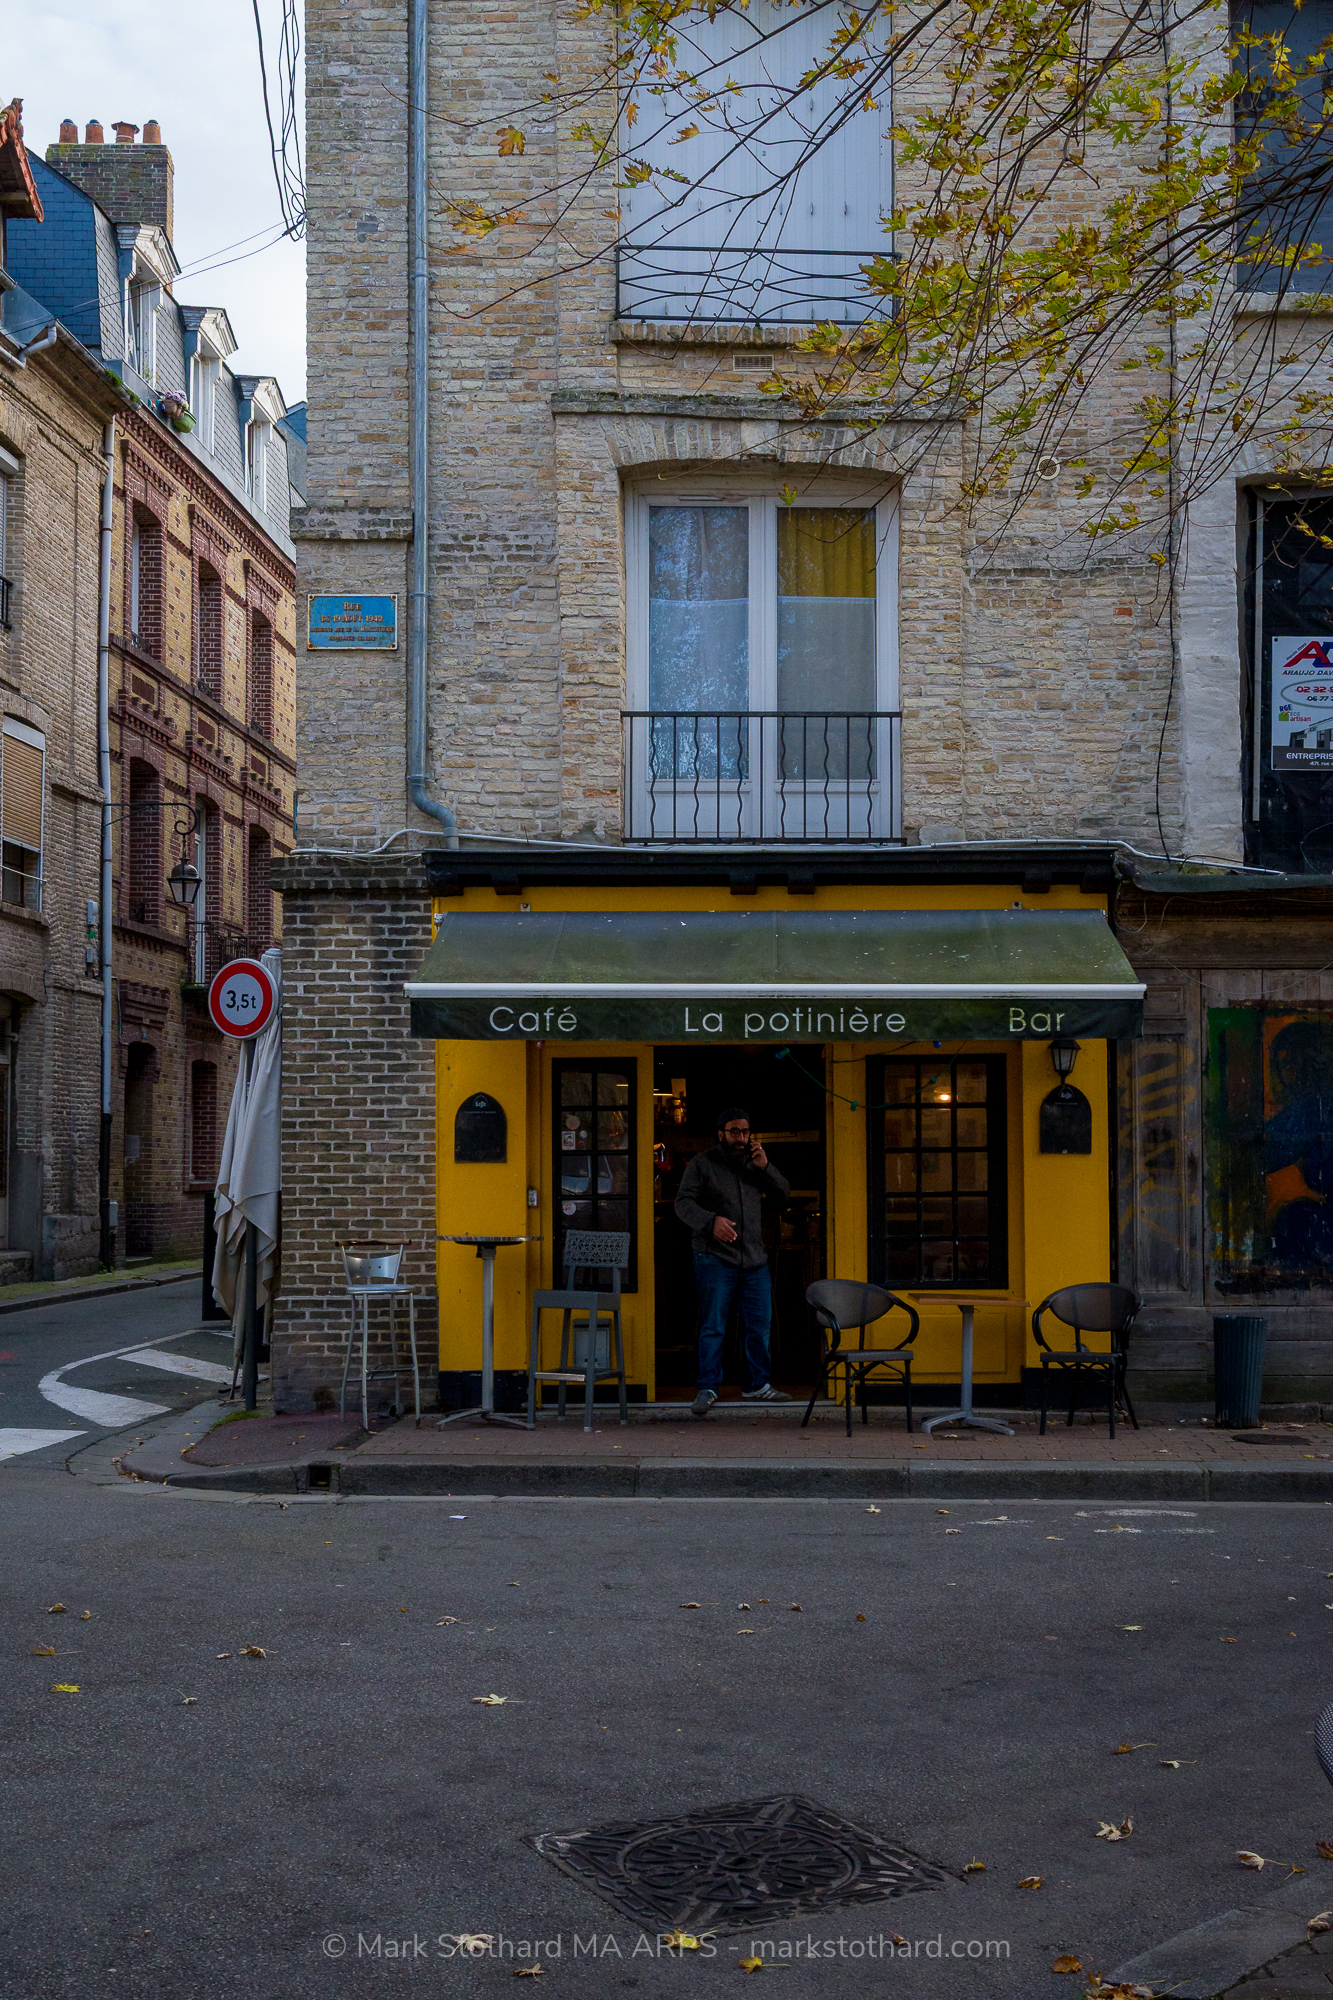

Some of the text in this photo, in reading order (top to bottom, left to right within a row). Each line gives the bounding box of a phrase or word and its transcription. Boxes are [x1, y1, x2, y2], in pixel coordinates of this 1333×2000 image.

[1279, 704, 1292, 712] RGE
[489, 1006, 1065, 1038] Café La potinière Bar
